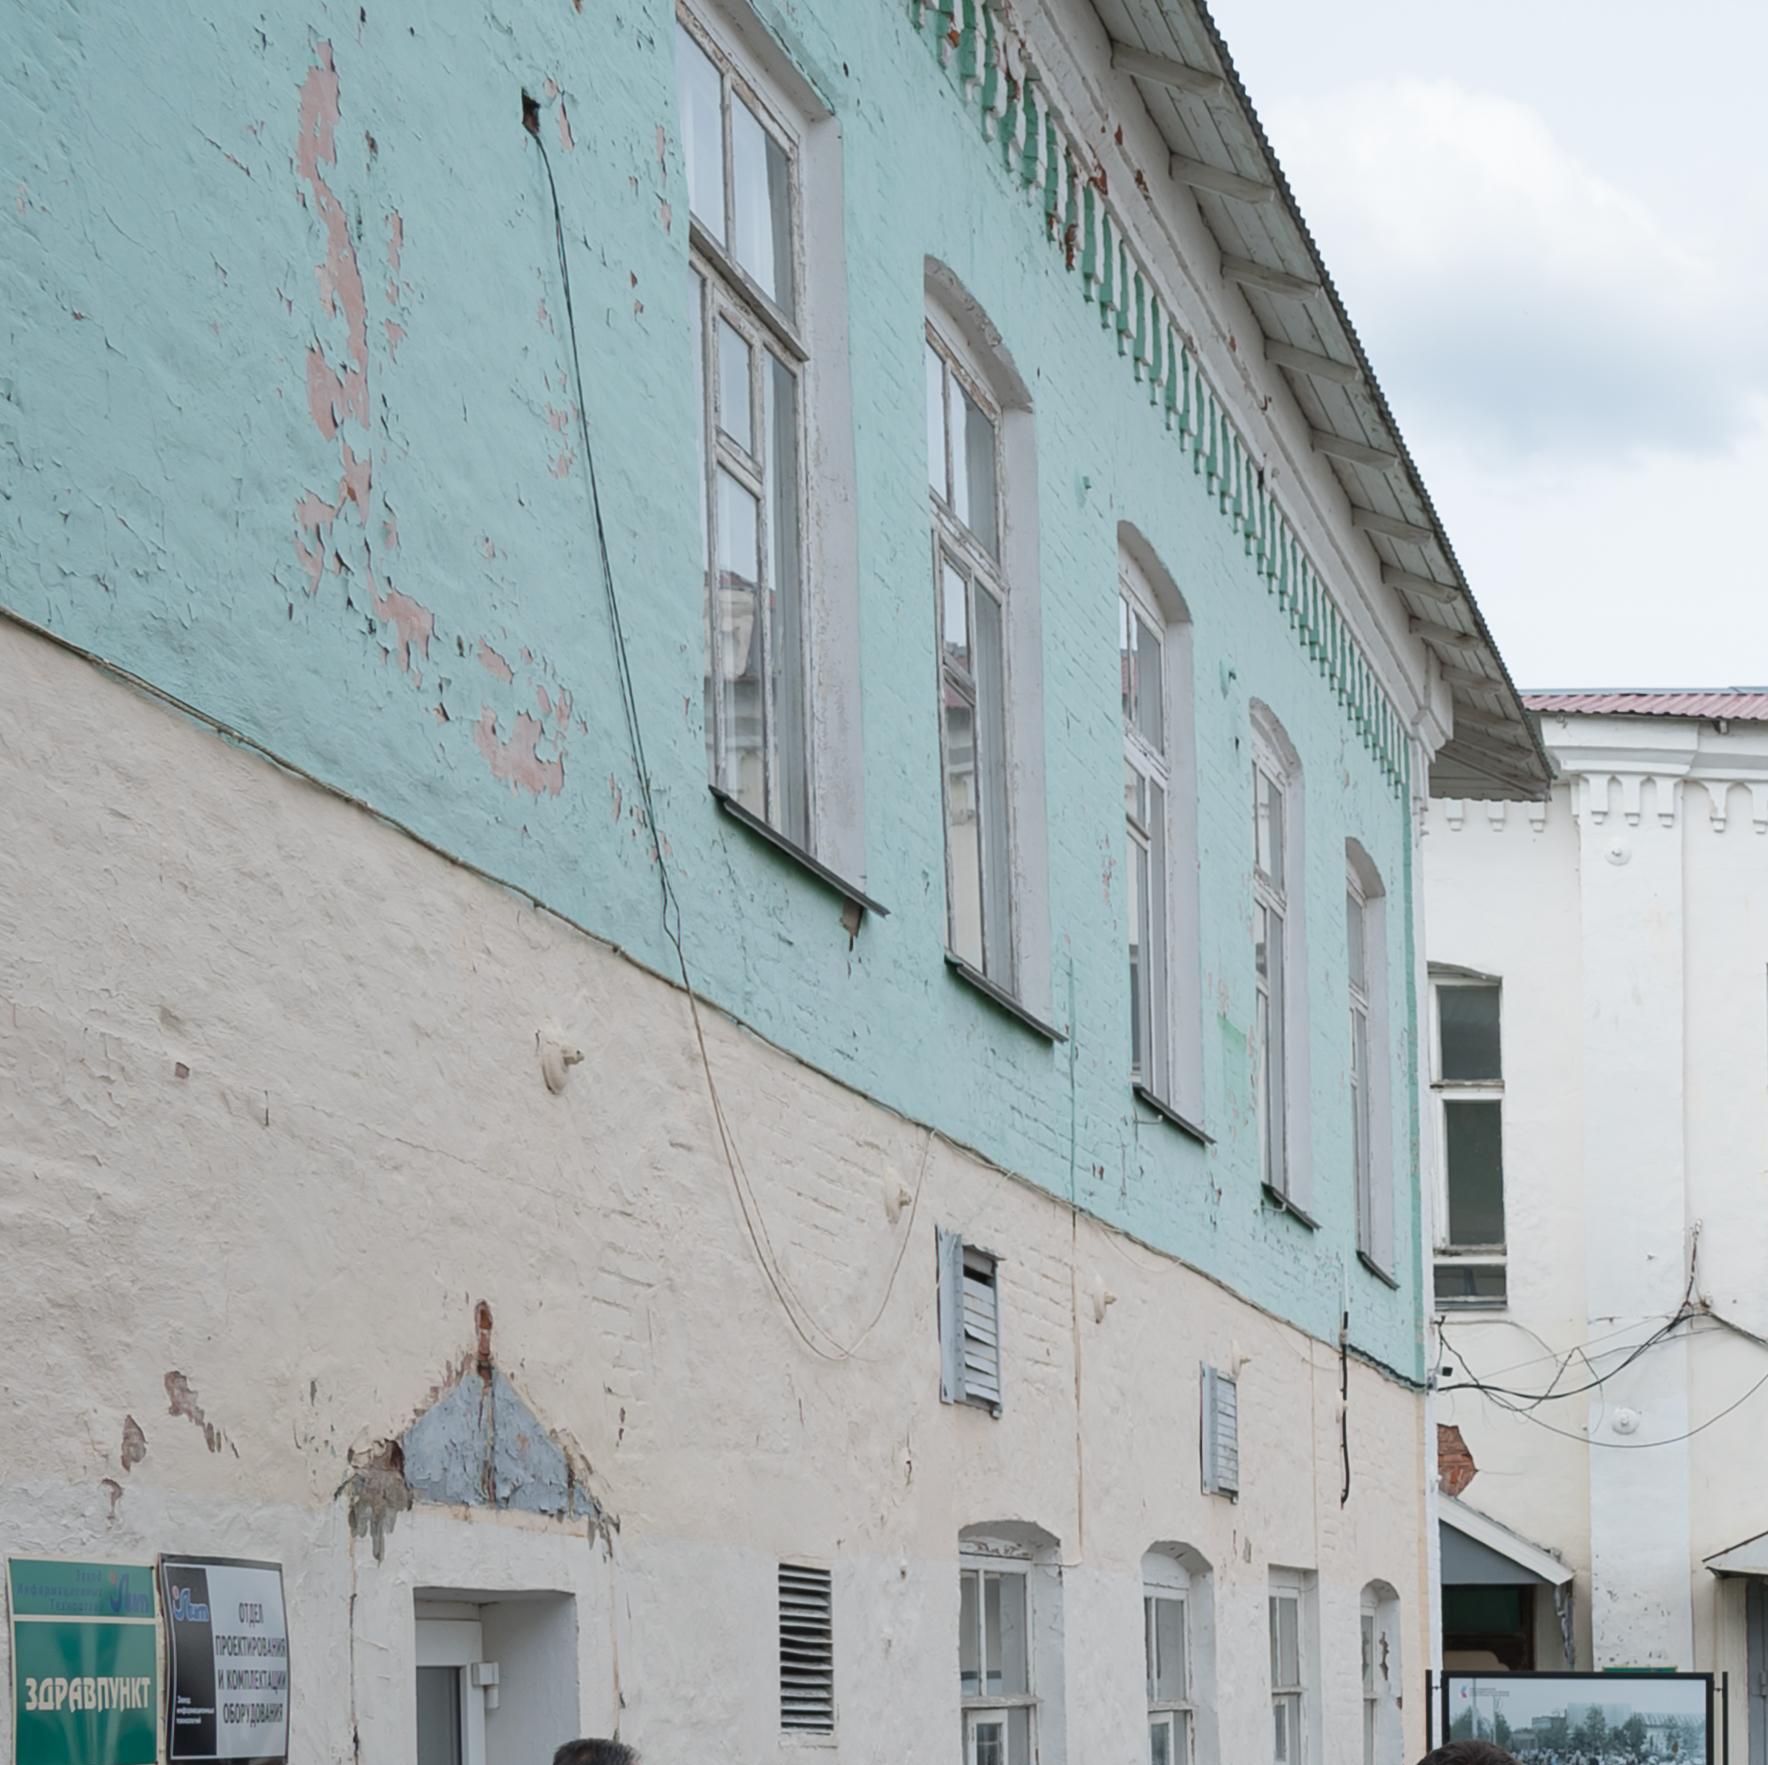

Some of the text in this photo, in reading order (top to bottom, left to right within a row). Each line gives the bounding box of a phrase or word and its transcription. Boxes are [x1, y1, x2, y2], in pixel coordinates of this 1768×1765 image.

[238, 1602, 263, 1628] ОТДЕЛ
[215, 1635, 287, 1658] ПРОЕКТИРОВАНИЯ
[25, 1677, 151, 1713] ЗДРАВПУНКТ
[217, 1669, 287, 1695] И КОМПЛЕКТАЦИИ
[223, 1703, 283, 1728] ОБОРУДОВАНИЯ
